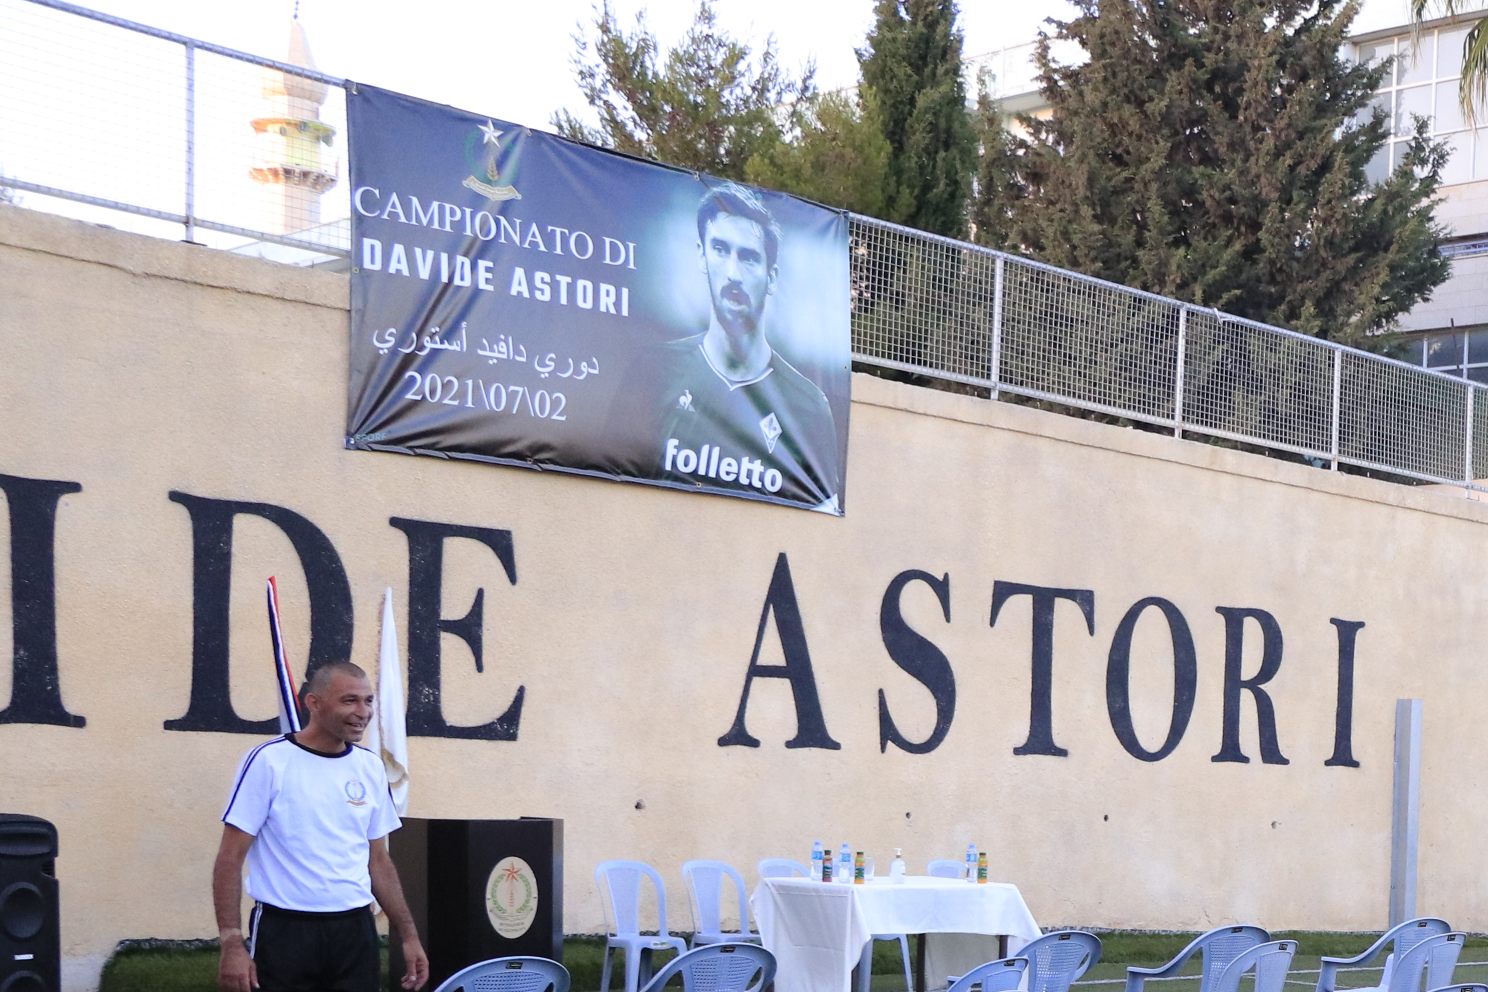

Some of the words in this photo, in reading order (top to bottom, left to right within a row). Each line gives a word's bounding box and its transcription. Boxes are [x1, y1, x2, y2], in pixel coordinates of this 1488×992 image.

[354, 186, 594, 260] CAMPIONATO
[602, 236, 637, 270] DI
[362, 237, 495, 291] DAVIDE
[509, 266, 629, 317] ASTORI
[372, 321, 468, 355] أستوري
[476, 333, 527, 365] دافيد
[533, 352, 600, 380] دوري
[404, 370, 567, 421] 2021\07\02
[664, 438, 783, 493] folletto
[716, 551, 1365, 769] ASTORI
